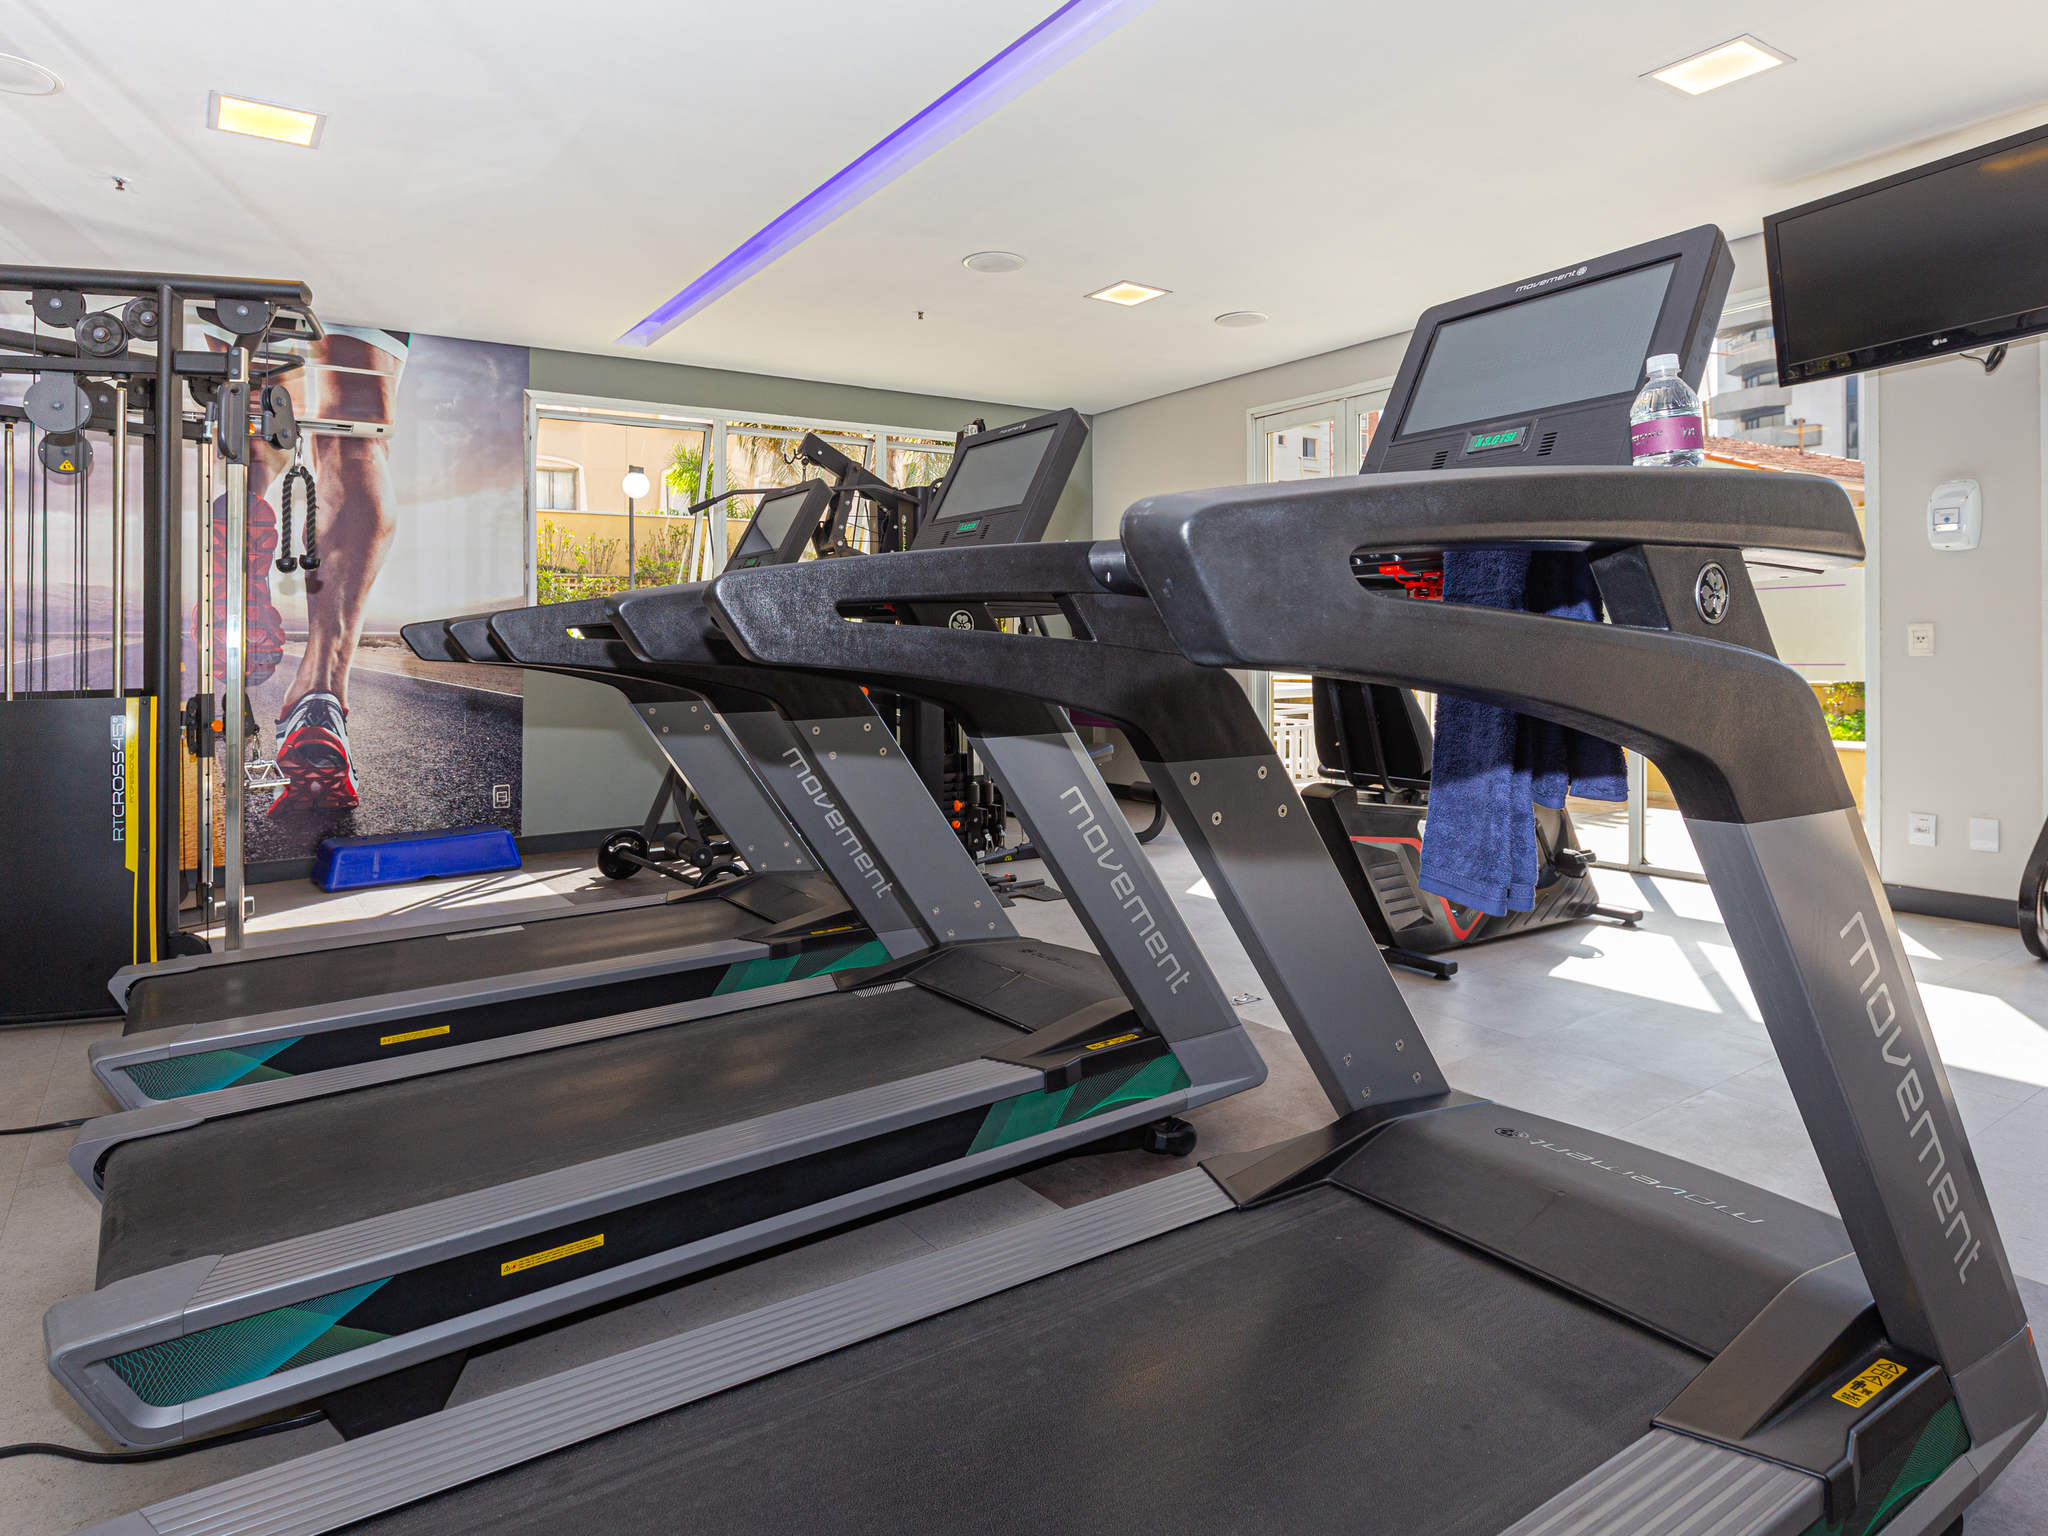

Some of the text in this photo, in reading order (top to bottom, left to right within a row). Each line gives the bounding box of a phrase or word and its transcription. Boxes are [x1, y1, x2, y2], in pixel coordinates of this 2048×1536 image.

[782, 747, 893, 899] movement
[1059, 785, 1191, 994] movement
[1529, 1138, 1765, 1224] movement
[1839, 911, 1981, 1285] movement
